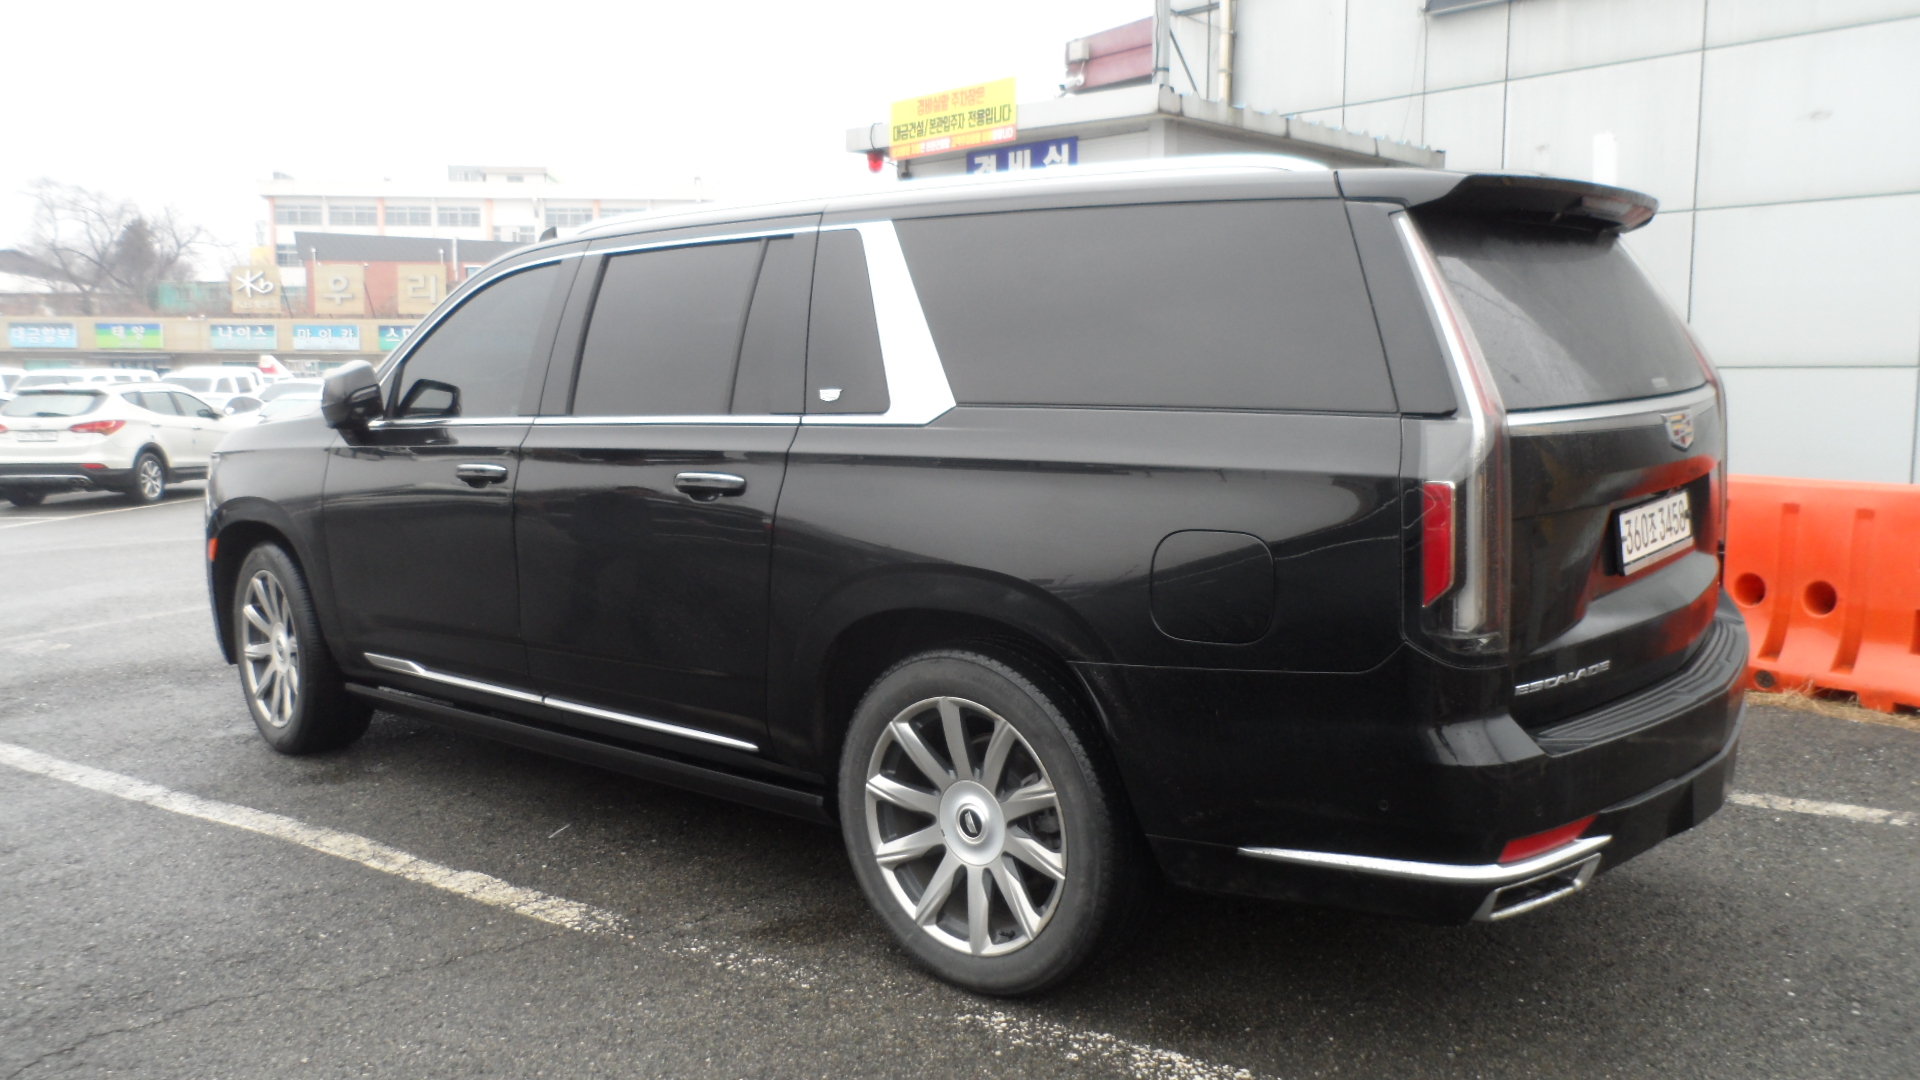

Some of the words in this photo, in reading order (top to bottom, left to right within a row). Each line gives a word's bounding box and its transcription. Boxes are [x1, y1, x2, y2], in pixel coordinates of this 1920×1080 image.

[967, 103, 1013, 129] 전용입니다
[218, 325, 267, 341] 나이스
[1514, 659, 1612, 696] ESCALADE
